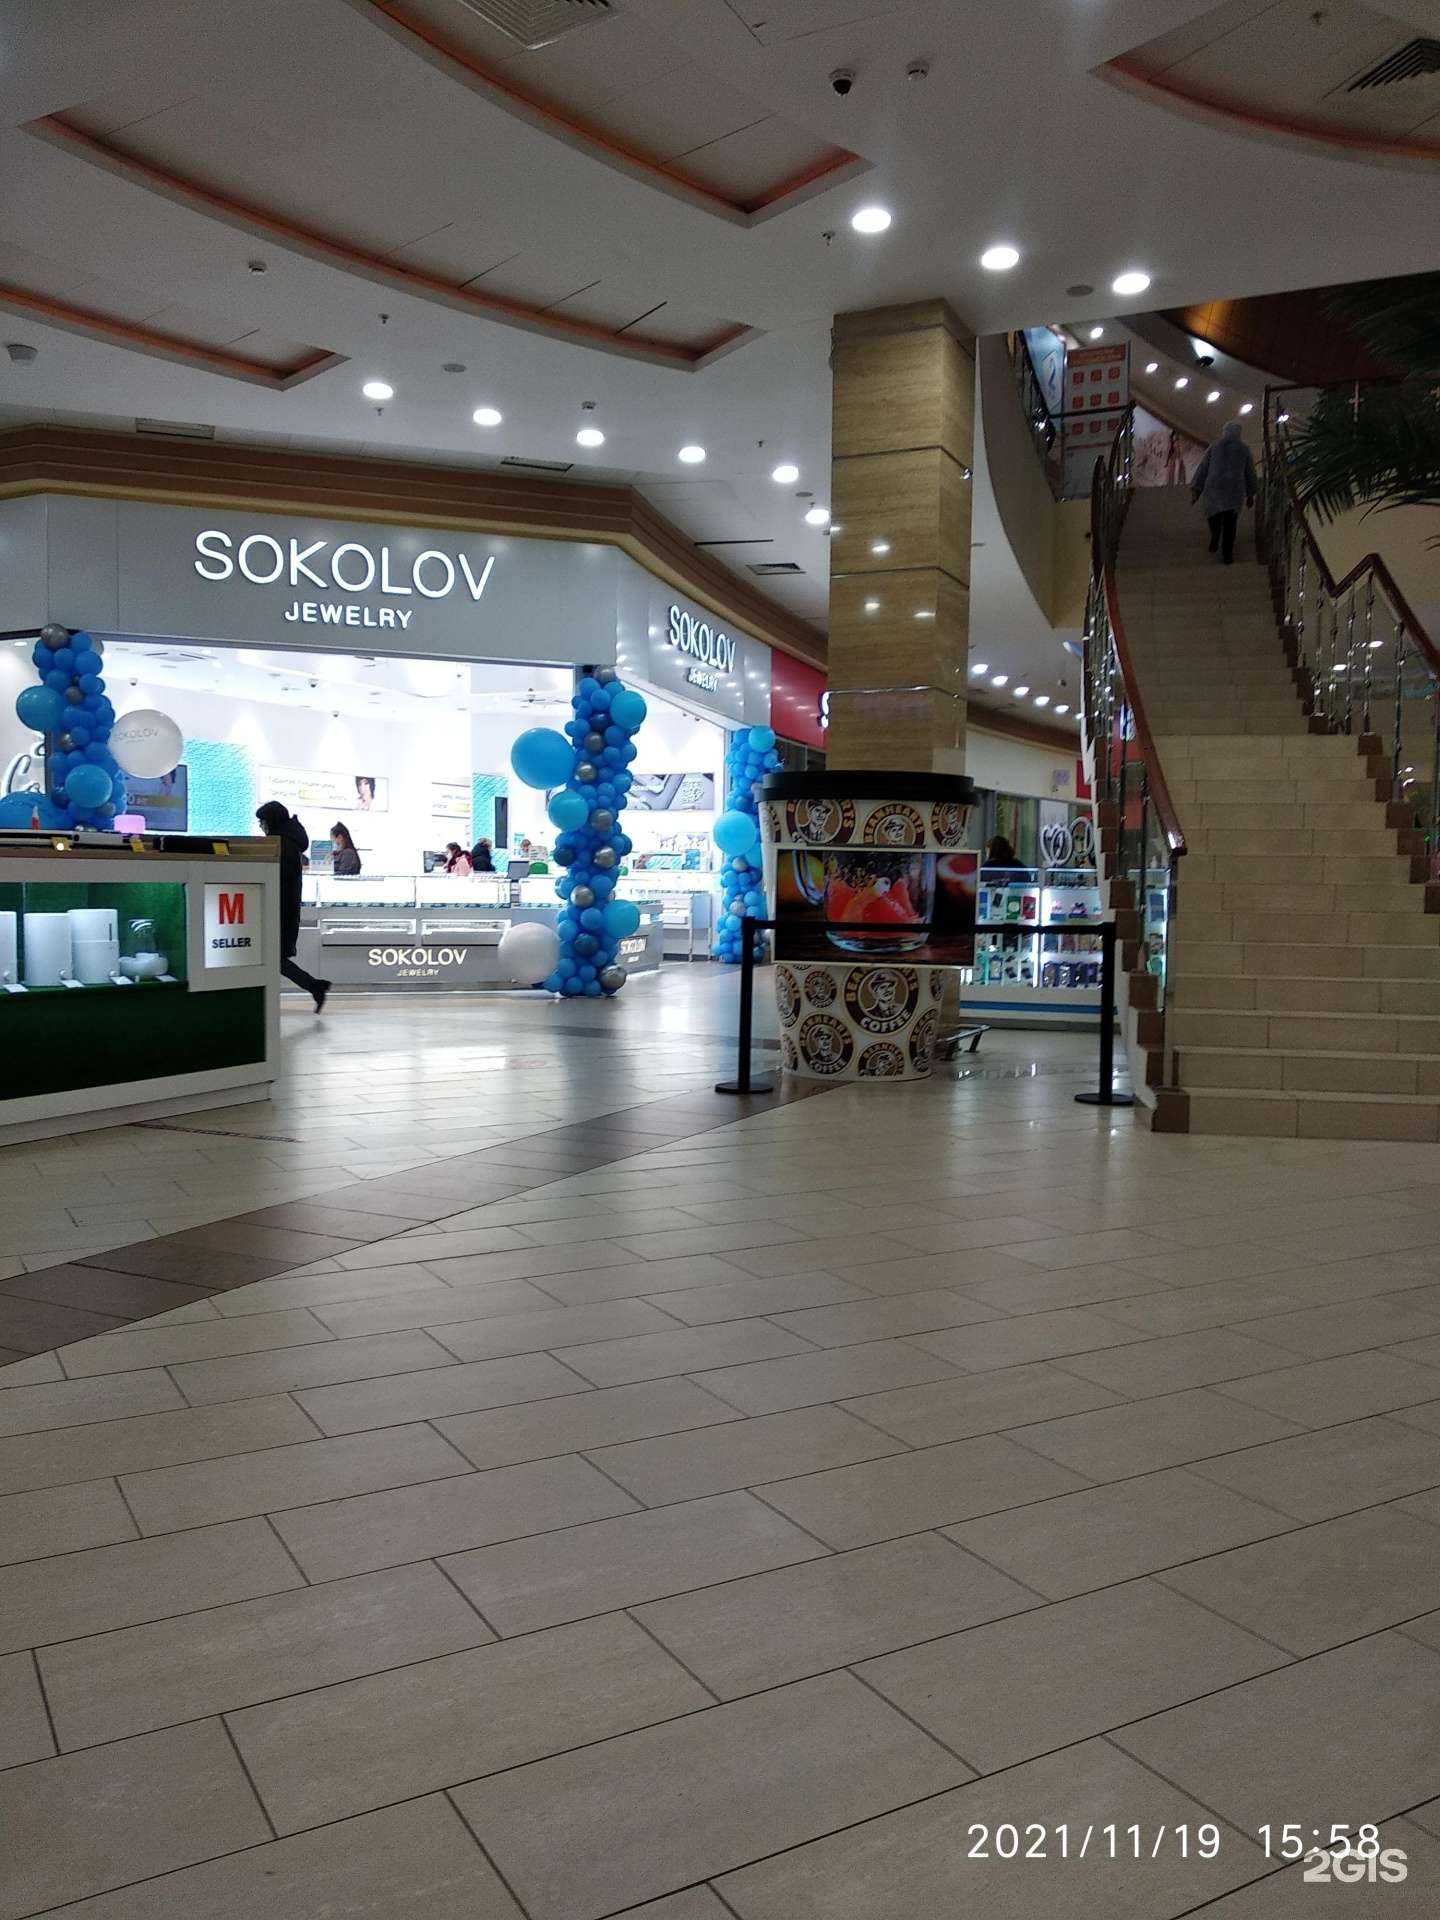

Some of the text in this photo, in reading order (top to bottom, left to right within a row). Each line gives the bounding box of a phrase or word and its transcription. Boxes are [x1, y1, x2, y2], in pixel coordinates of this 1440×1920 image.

[194, 530, 495, 600] SOKOLOV
[284, 601, 413, 629] JEWELRY
[669, 605, 736, 673] SOKOLOV
[218, 893, 245, 925] M
[211, 937, 252, 949] SELLER
[368, 948, 467, 966] SOKOLOV
[396, 968, 440, 977] JEWELRY
[861, 1008, 912, 1033] COFFEE
